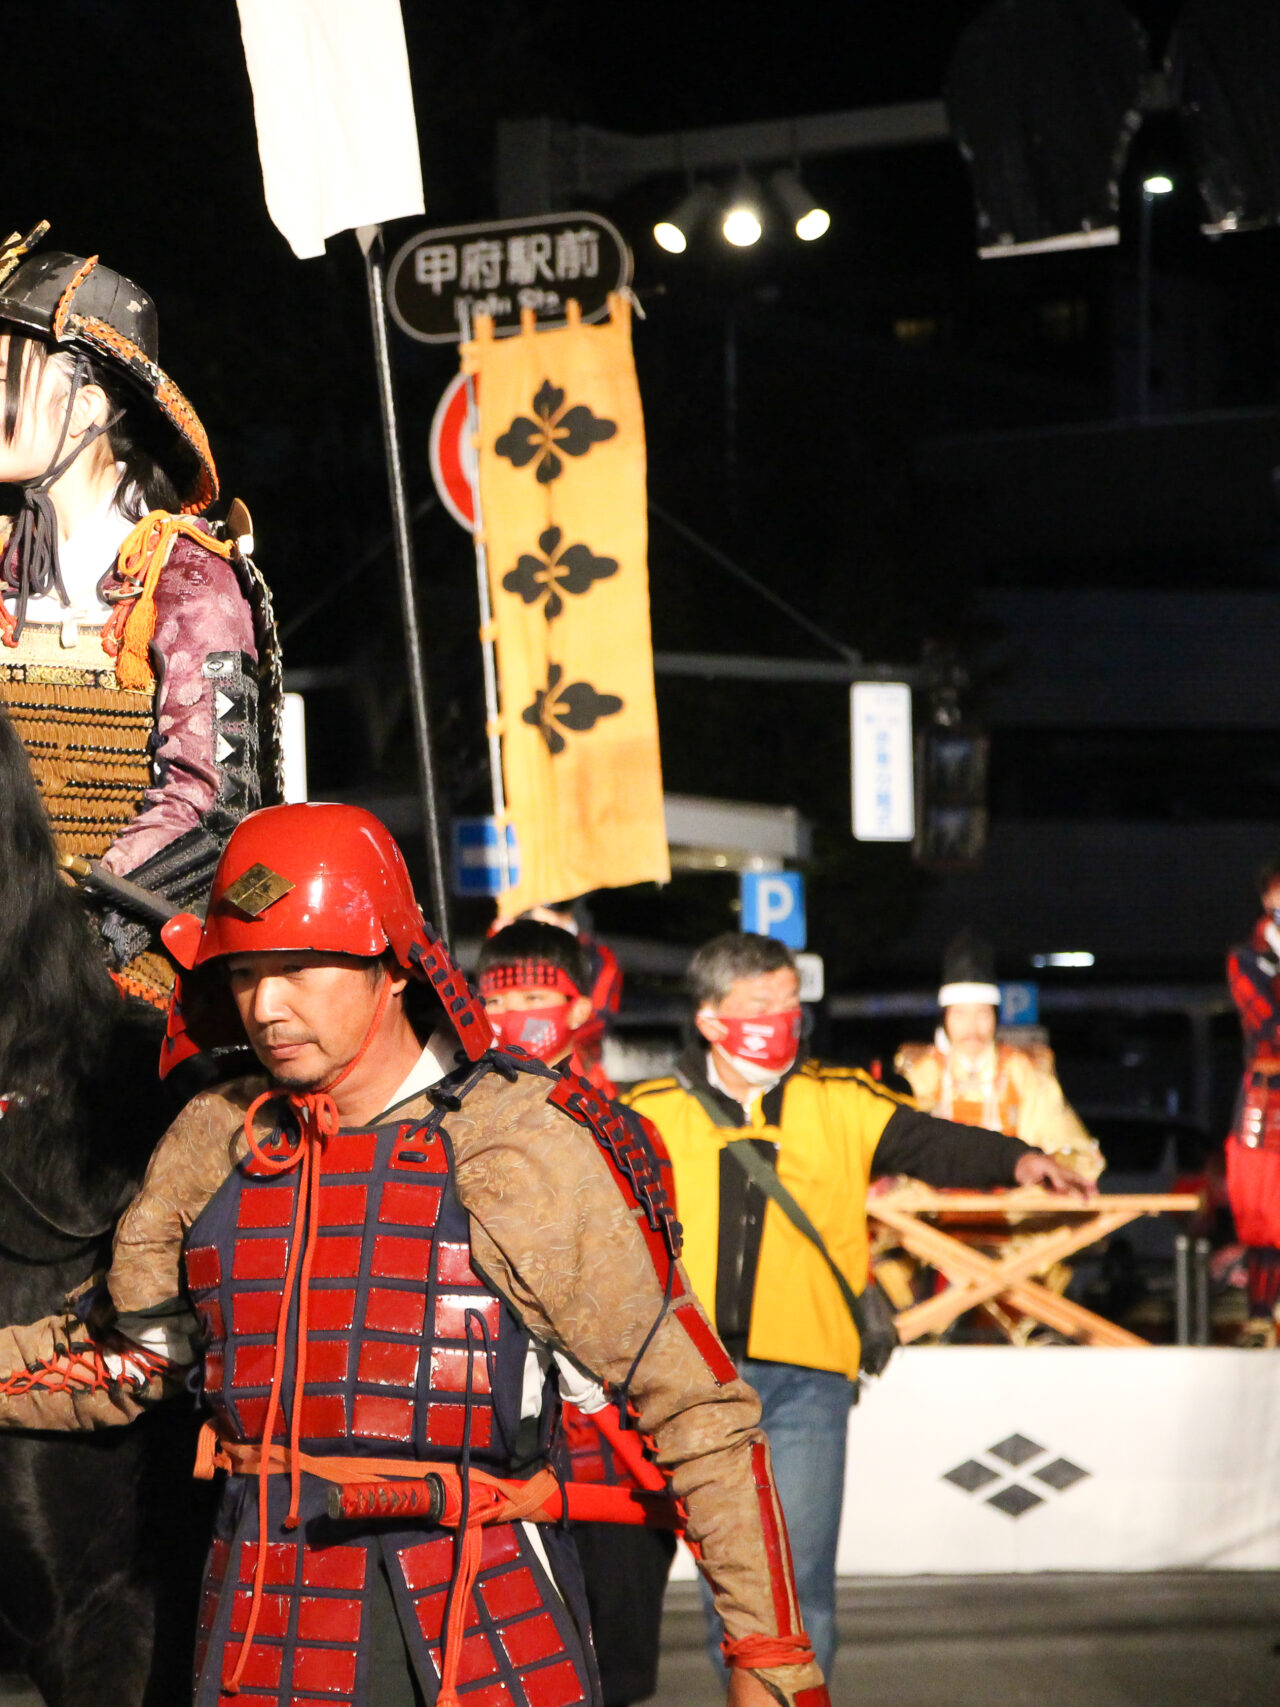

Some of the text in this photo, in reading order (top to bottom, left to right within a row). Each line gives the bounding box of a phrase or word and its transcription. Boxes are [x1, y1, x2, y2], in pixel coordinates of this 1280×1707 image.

[415, 227, 599, 296] 甲府駅前
[757, 879, 794, 936] P
[1005, 984, 1030, 1022] P
